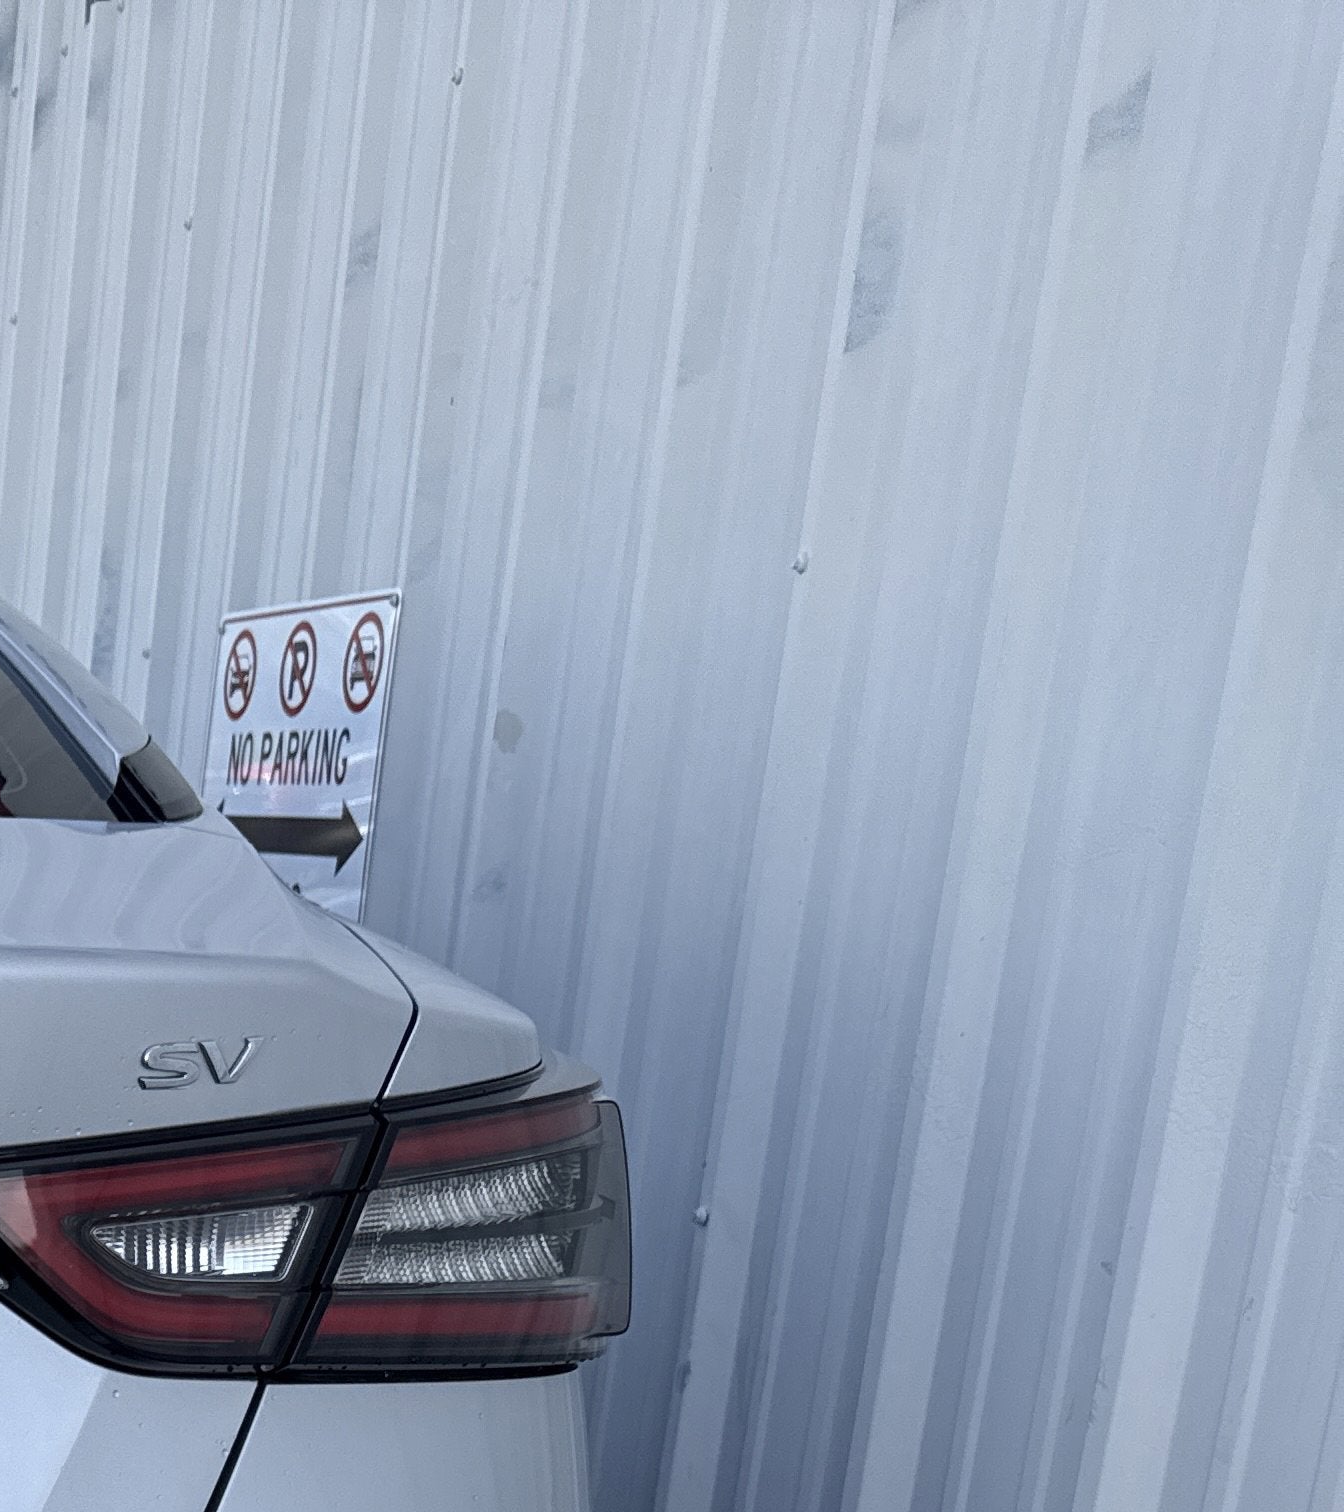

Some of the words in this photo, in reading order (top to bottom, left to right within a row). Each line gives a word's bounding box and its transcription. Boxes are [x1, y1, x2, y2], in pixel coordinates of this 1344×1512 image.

[226, 732, 254, 786] NO
[256, 727, 351, 786] PARKING
[137, 1035, 265, 1091] SV
